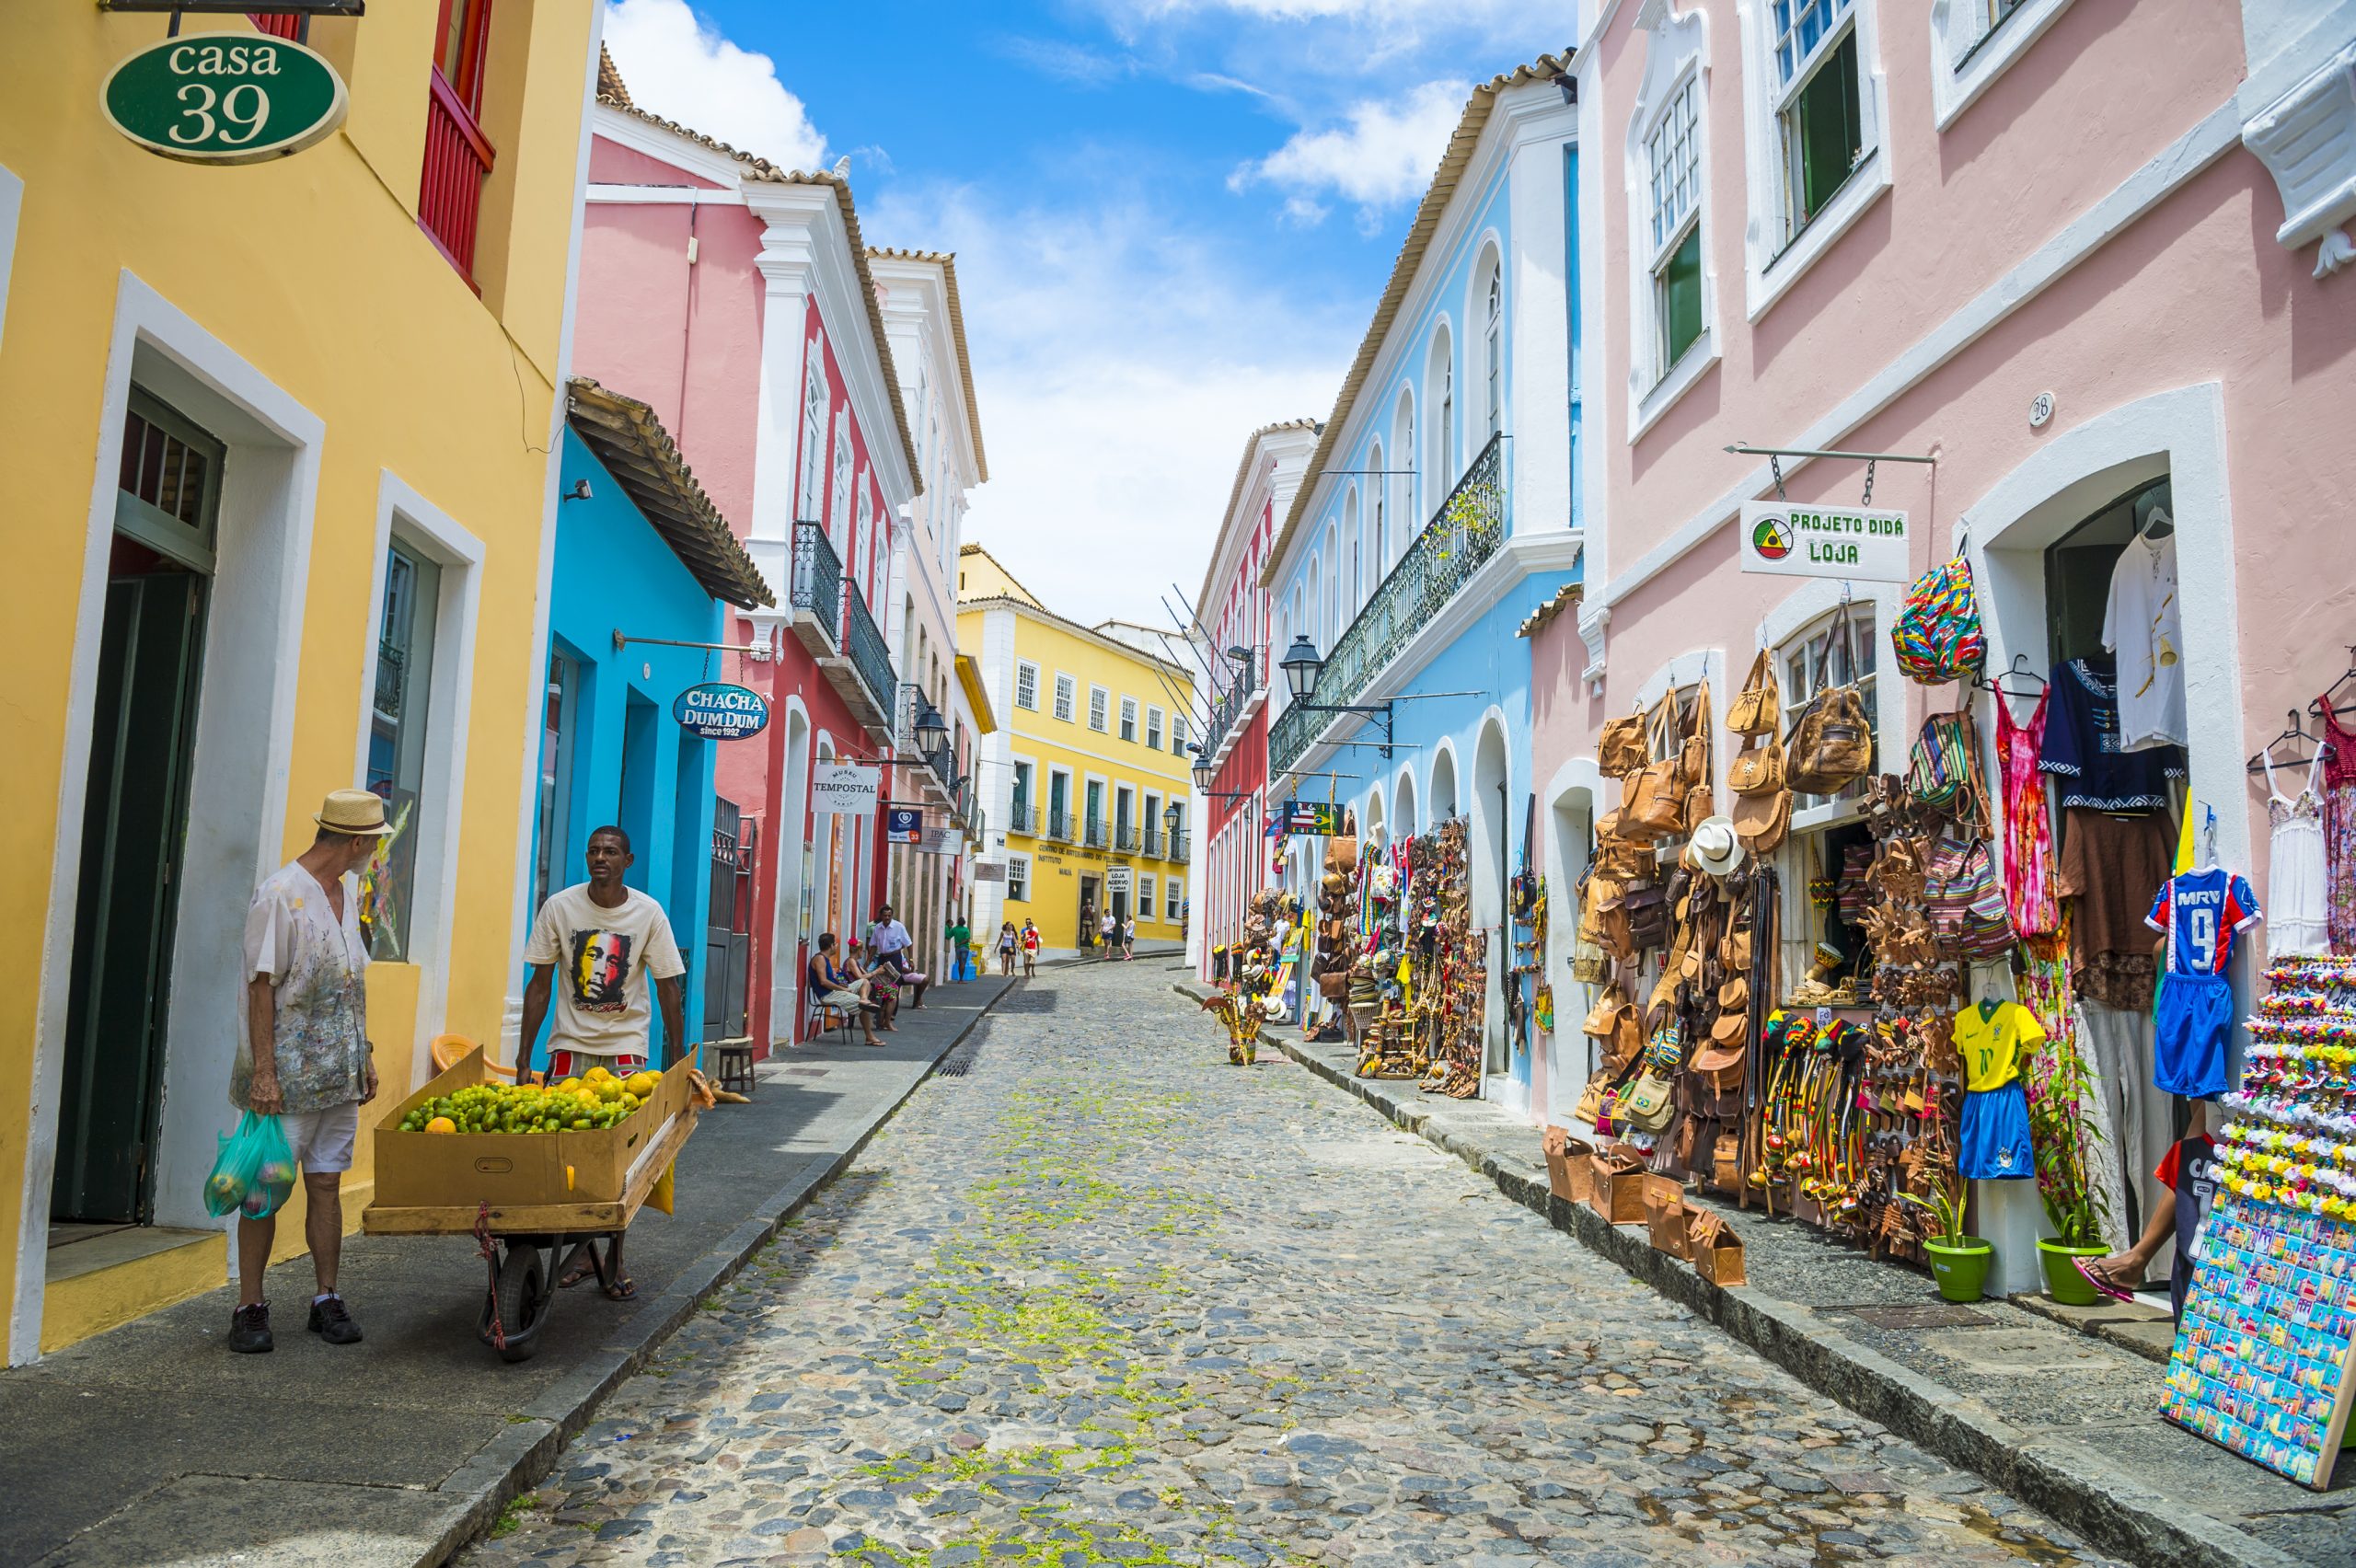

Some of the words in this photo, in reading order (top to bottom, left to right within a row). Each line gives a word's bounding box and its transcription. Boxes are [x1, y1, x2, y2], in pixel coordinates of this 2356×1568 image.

[169, 46, 282, 75] casa
[168, 84, 270, 144] 39
[2034, 397, 2049, 421] 28
[1790, 513, 1863, 533] PROJETO
[1869, 517, 1903, 536] DIDÁ
[1809, 542, 1858, 563] LOJA
[699, 726, 722, 736] since
[722, 728, 740, 737] 1992
[832, 769, 857, 778] MUSEU
[814, 782, 876, 793] TEMPOSTAL
[930, 830, 951, 838] IPAC
[1038, 845, 1057, 854] CENTRO
[1058, 847, 1065, 855] DE
[1038, 855, 1062, 864] INSTITUTO
[2177, 890, 2221, 906] MRV
[2191, 908, 2215, 970] 9
[1980, 1047, 1994, 1077] 10
